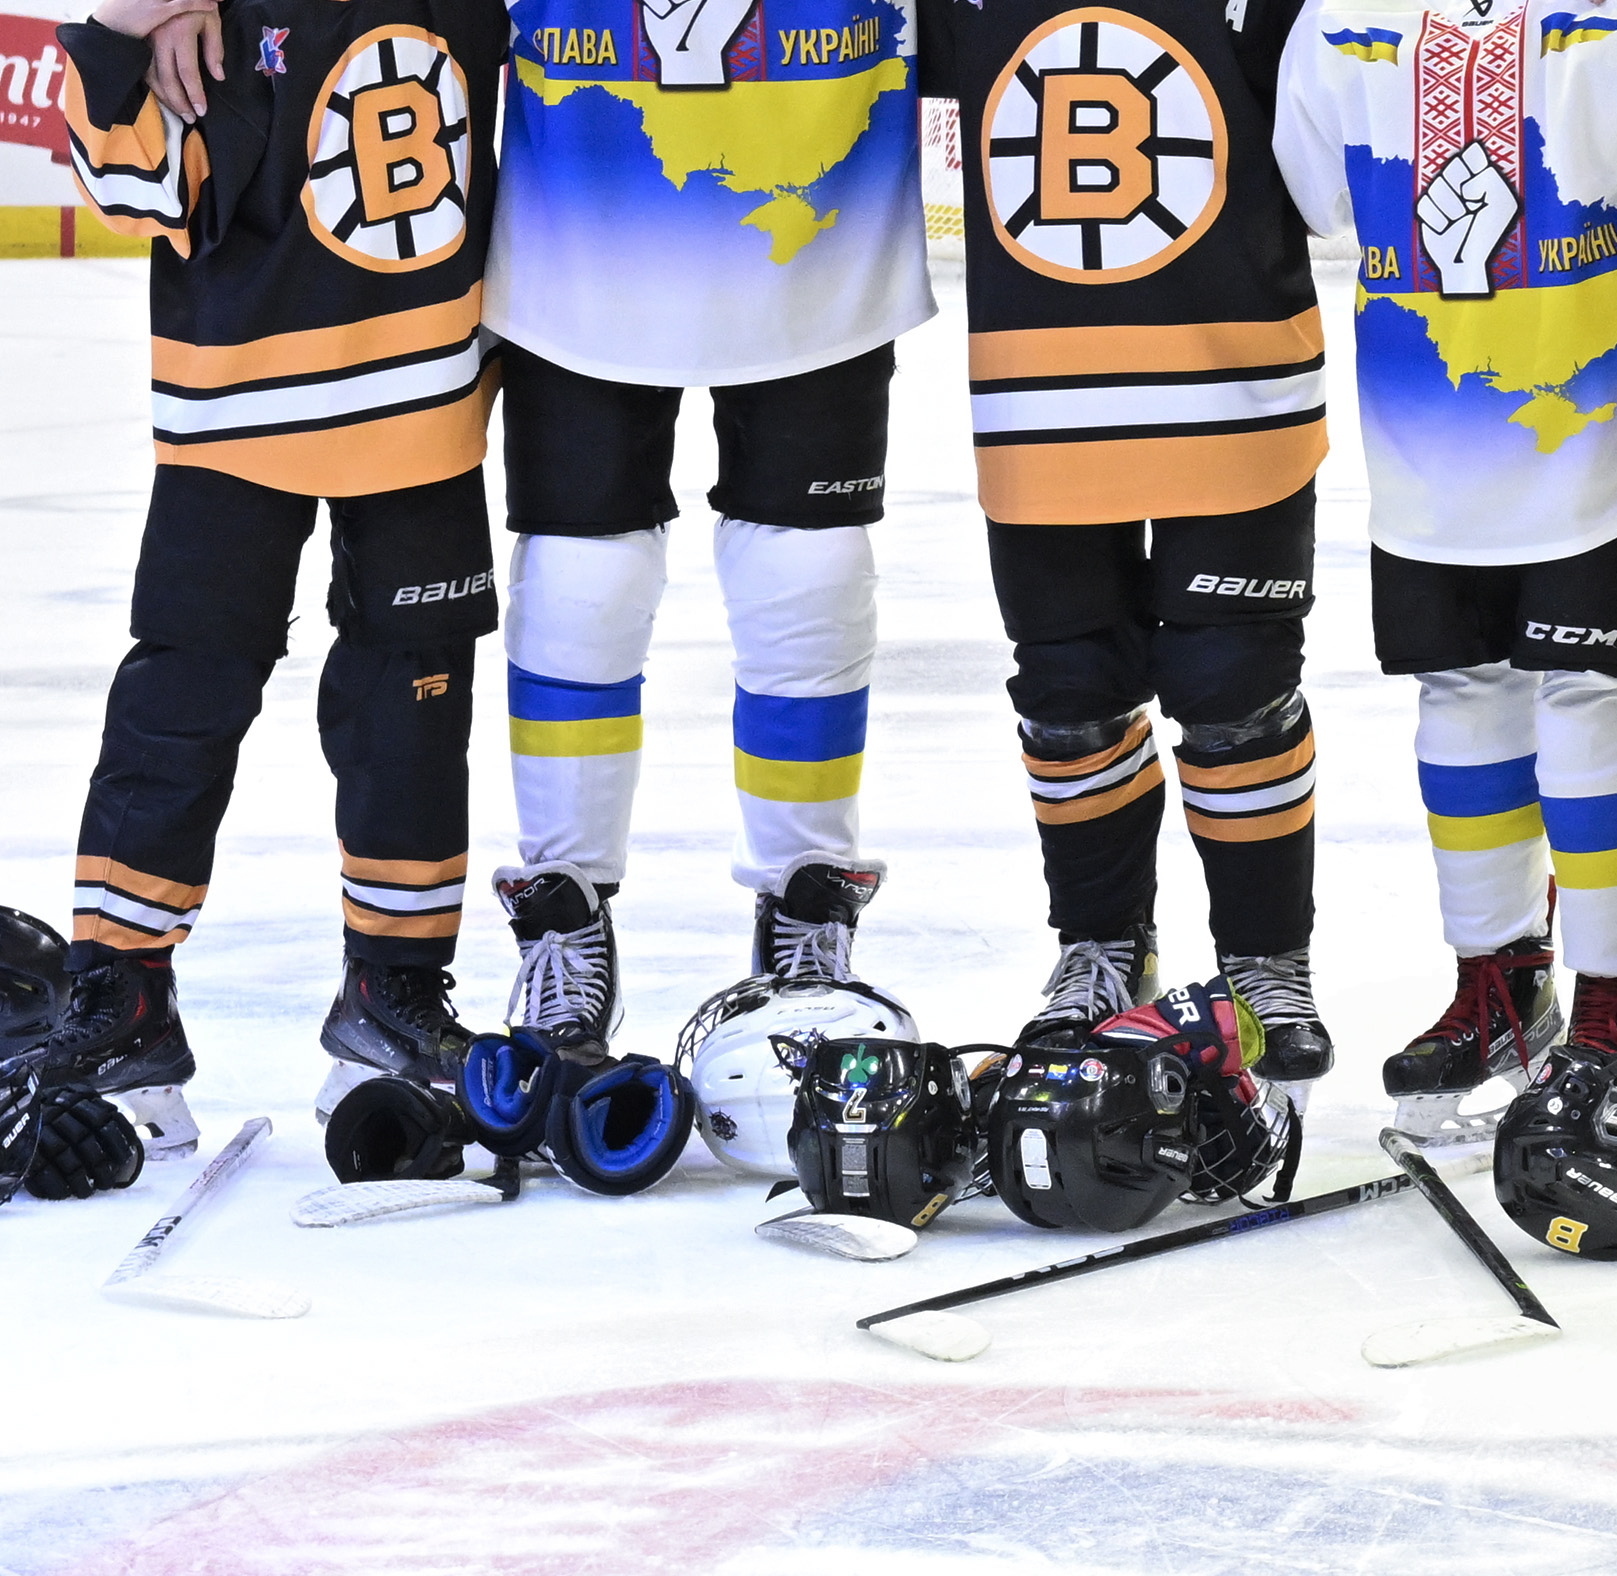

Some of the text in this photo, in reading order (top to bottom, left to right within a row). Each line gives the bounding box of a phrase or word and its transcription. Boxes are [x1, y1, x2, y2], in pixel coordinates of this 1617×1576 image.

[1461, 19, 1494, 28] BAUER
[779, 15, 879, 66] УКРАЇНІ!
[354, 81, 453, 223] B
[1042, 74, 1152, 220] B
[808, 474, 885, 495] EASTON
[1187, 573, 1306, 599] BAUER
[413, 674, 449, 702] TPS
[1545, 1215, 1589, 1254] B
